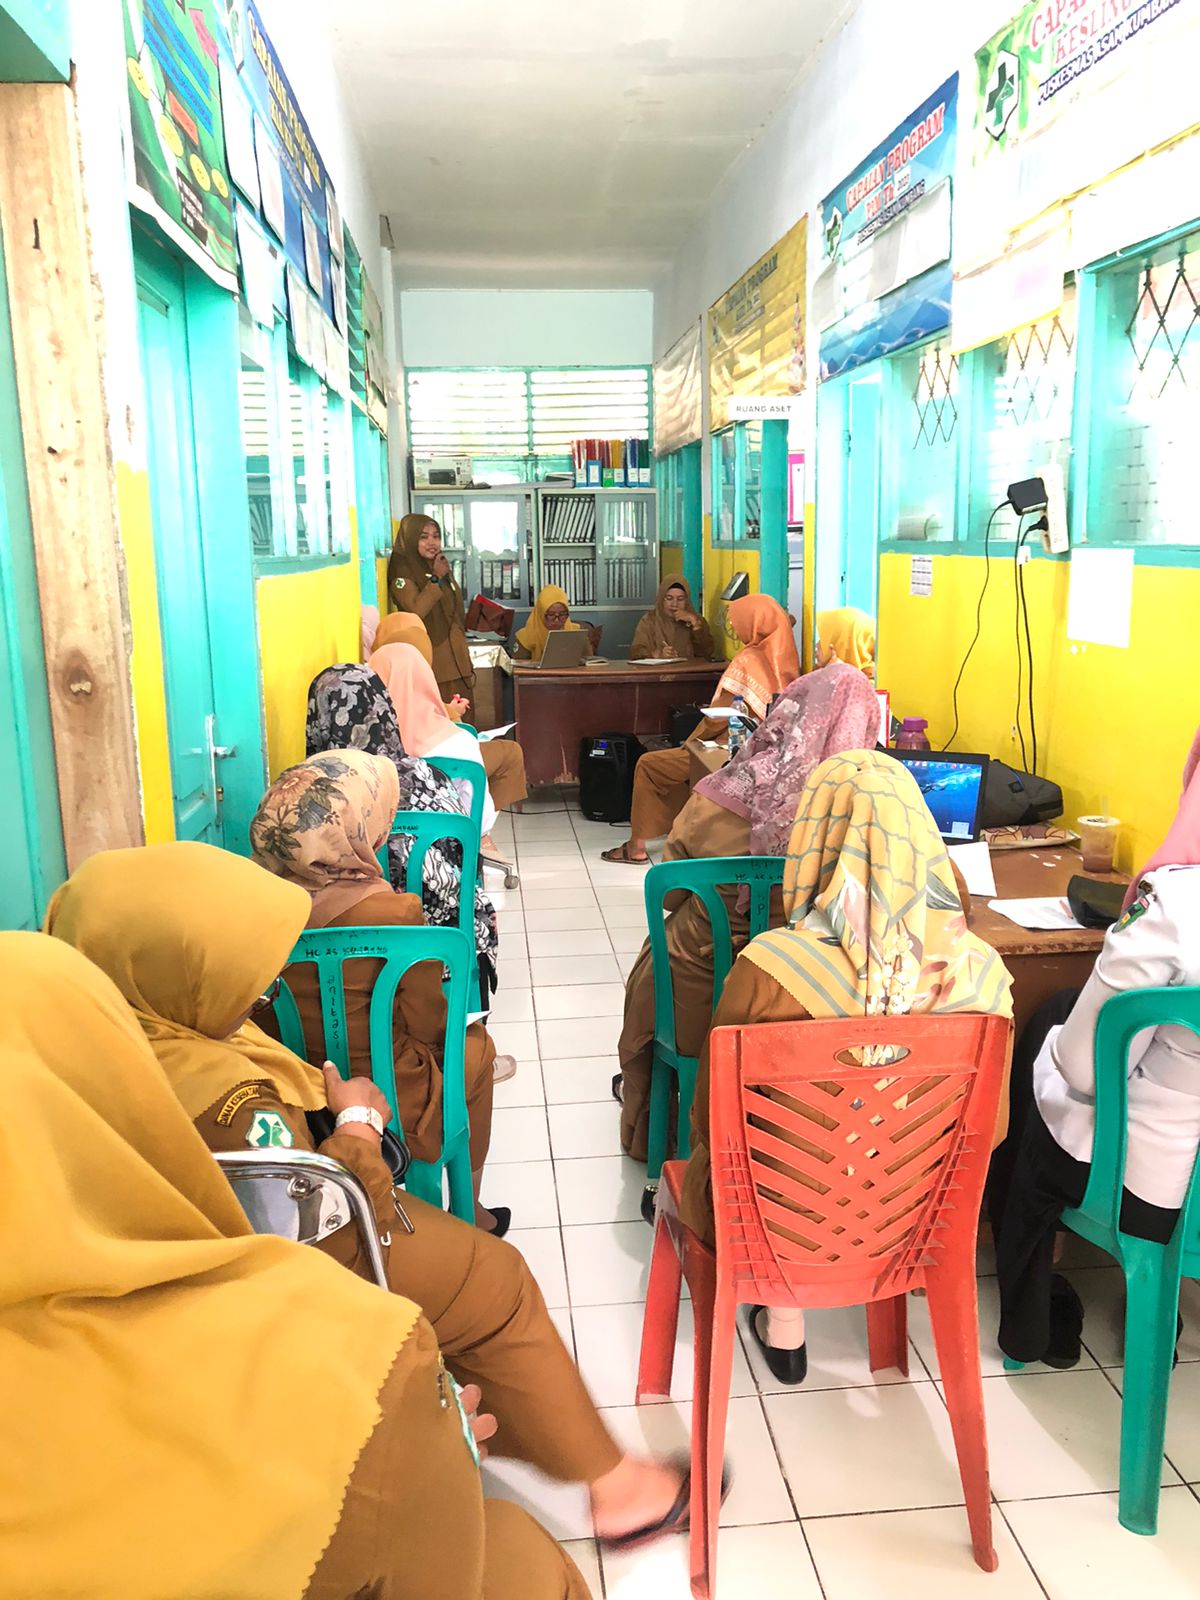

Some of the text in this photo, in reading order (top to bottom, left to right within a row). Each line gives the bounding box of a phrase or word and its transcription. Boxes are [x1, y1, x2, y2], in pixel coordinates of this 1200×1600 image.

[1032, 0, 1086, 47] CAPA
[846, 103, 945, 212] CAPAIAN PROGRAM
